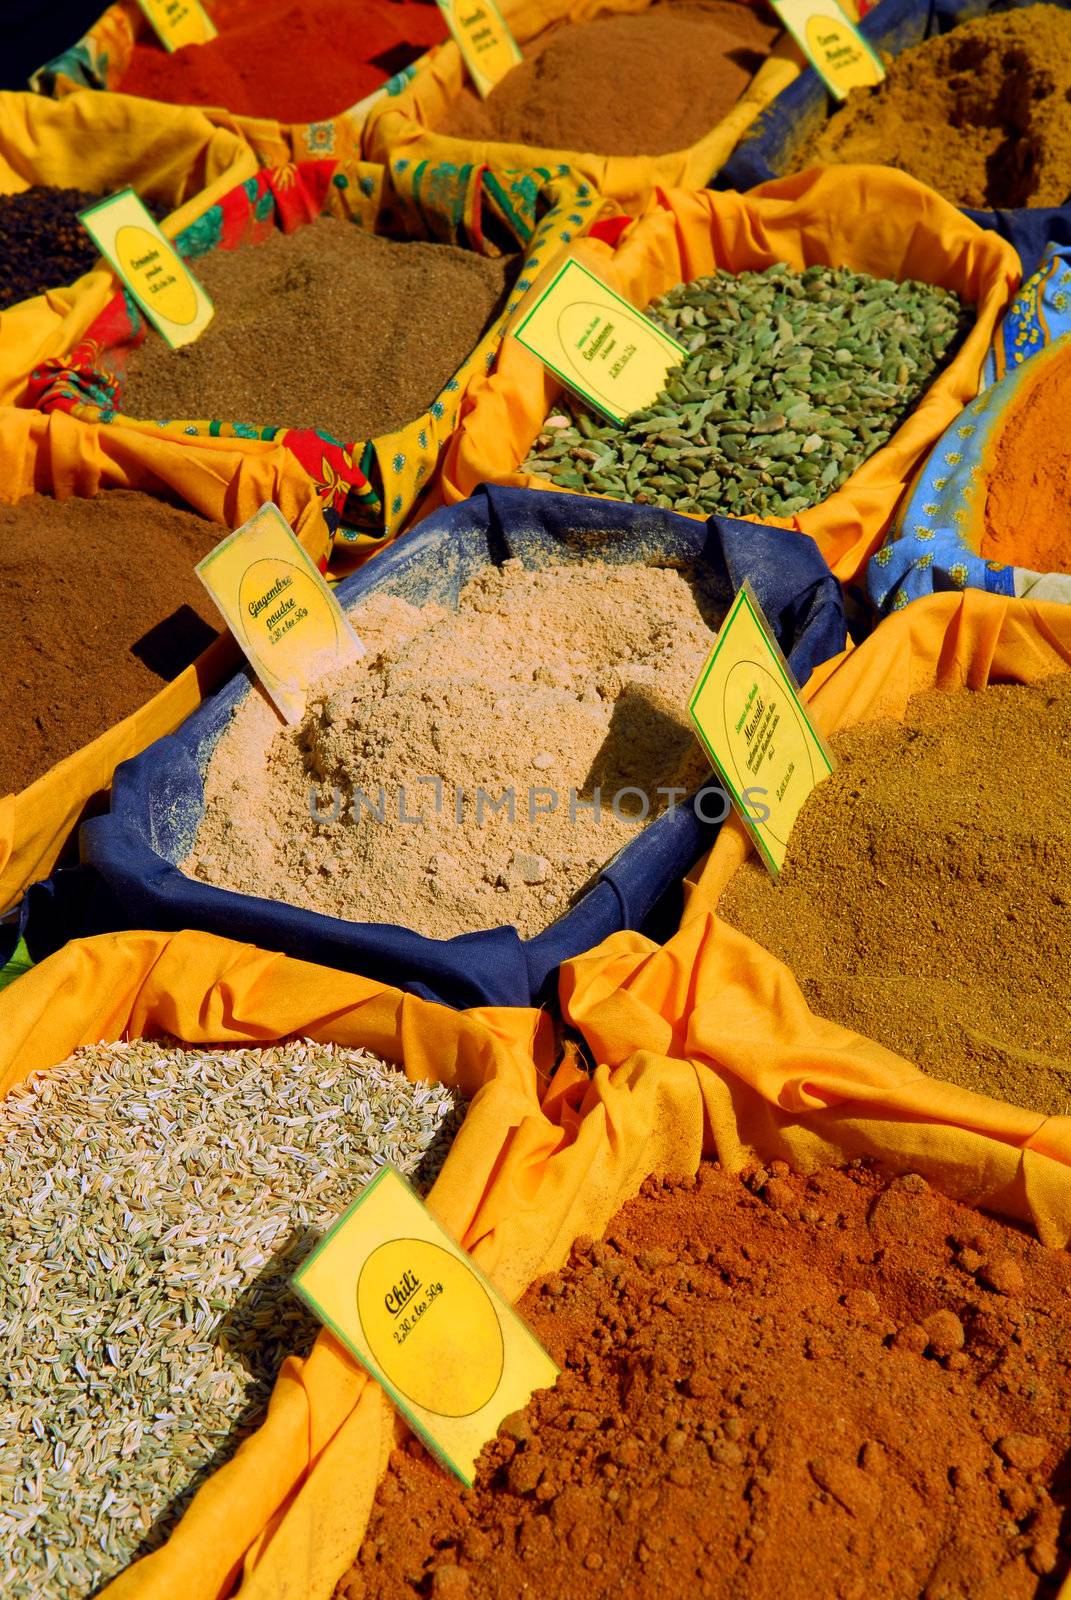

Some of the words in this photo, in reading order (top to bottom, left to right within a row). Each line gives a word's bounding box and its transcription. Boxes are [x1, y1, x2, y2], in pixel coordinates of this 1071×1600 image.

[248, 575, 293, 618] Gingembre
[266, 598, 296, 631] poudre
[385, 1269, 420, 1315] Chili
[393, 1318, 411, 1344] 2,30
[414, 1302, 426, 1316] les
[425, 1282, 443, 1301] 50g
